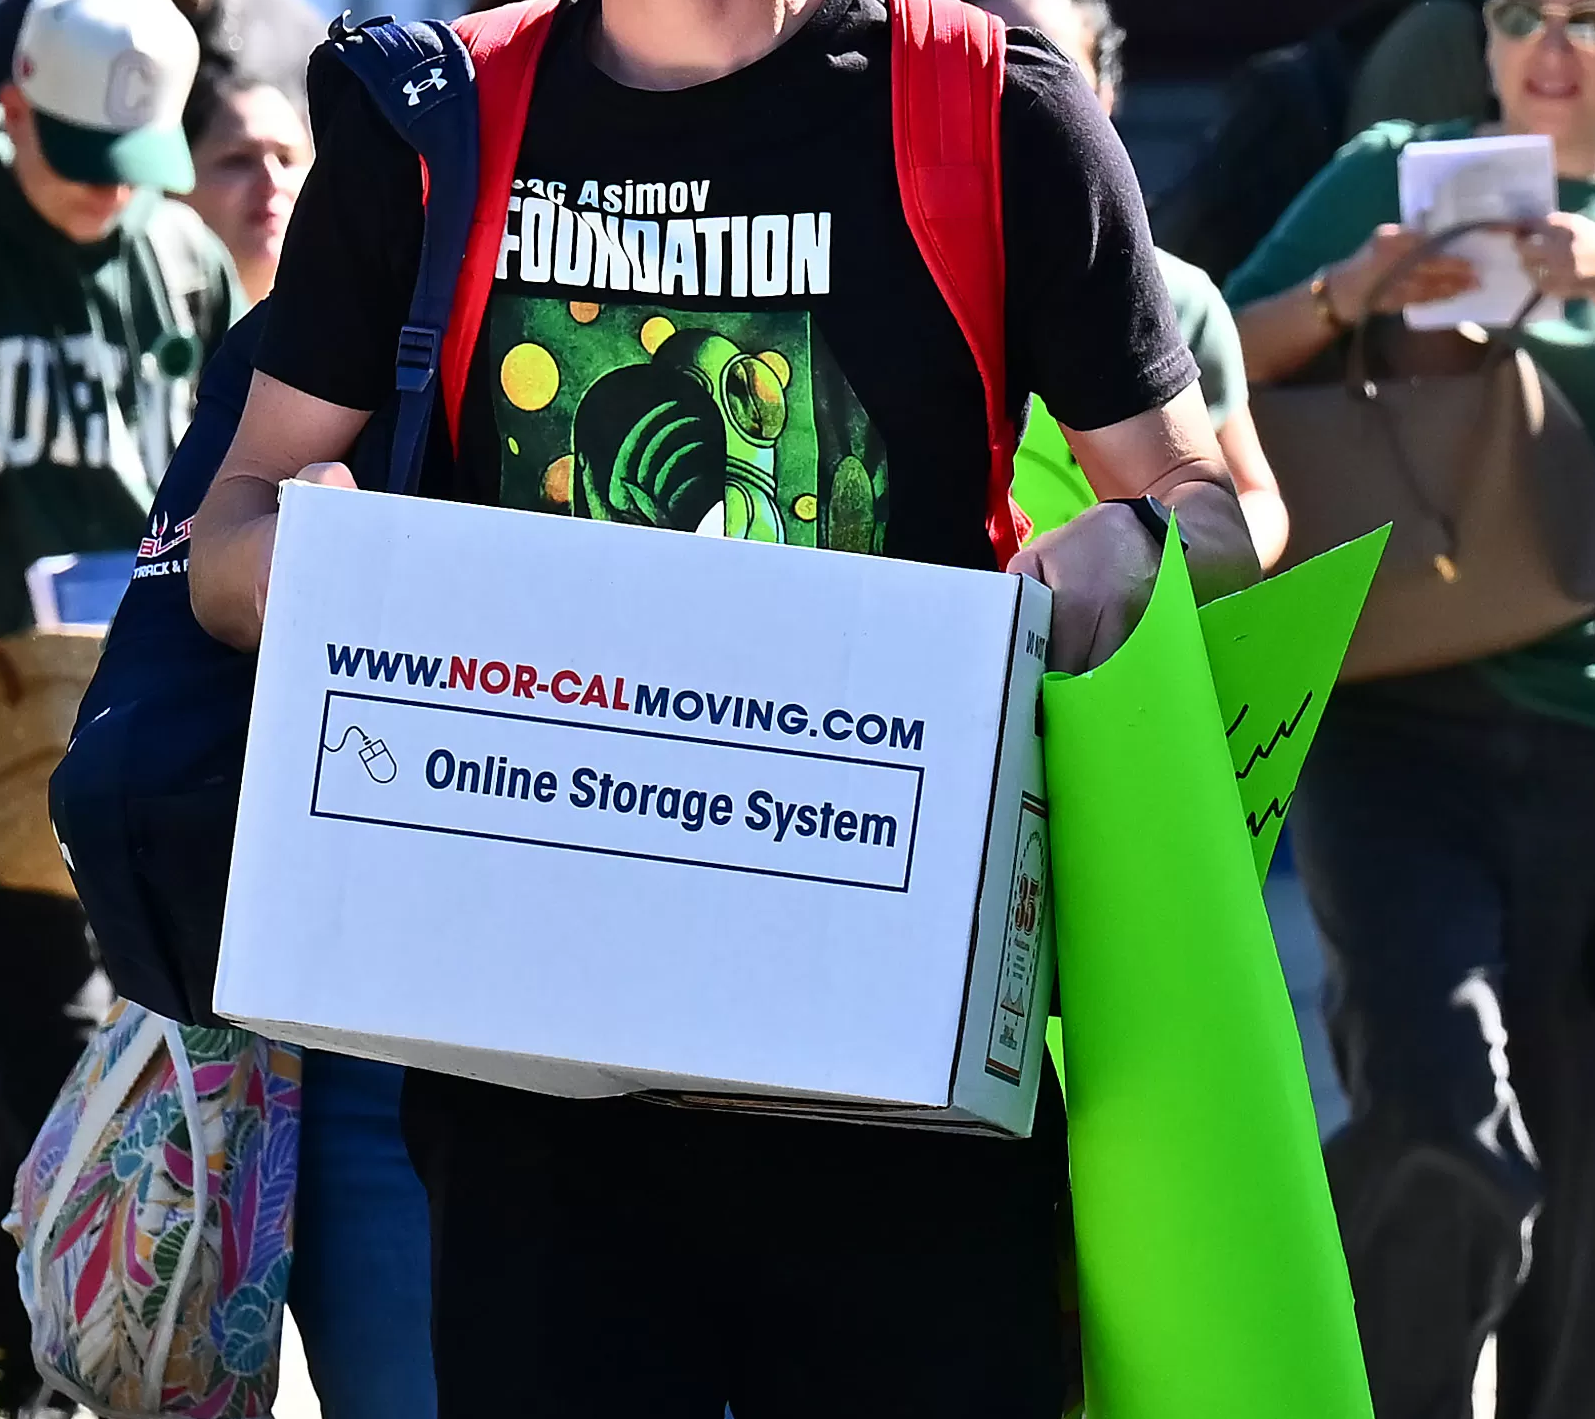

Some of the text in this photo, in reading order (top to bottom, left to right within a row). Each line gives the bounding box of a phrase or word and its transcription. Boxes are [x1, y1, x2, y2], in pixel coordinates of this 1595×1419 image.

[495, 196, 832, 298] FOUNDATION
[133, 561, 170, 580] TRACK
[172, 560, 181, 574] &
[326, 643, 926, 751] WWW.NOR-CALMOVING.COM
[425, 748, 897, 848] Online Storage System
